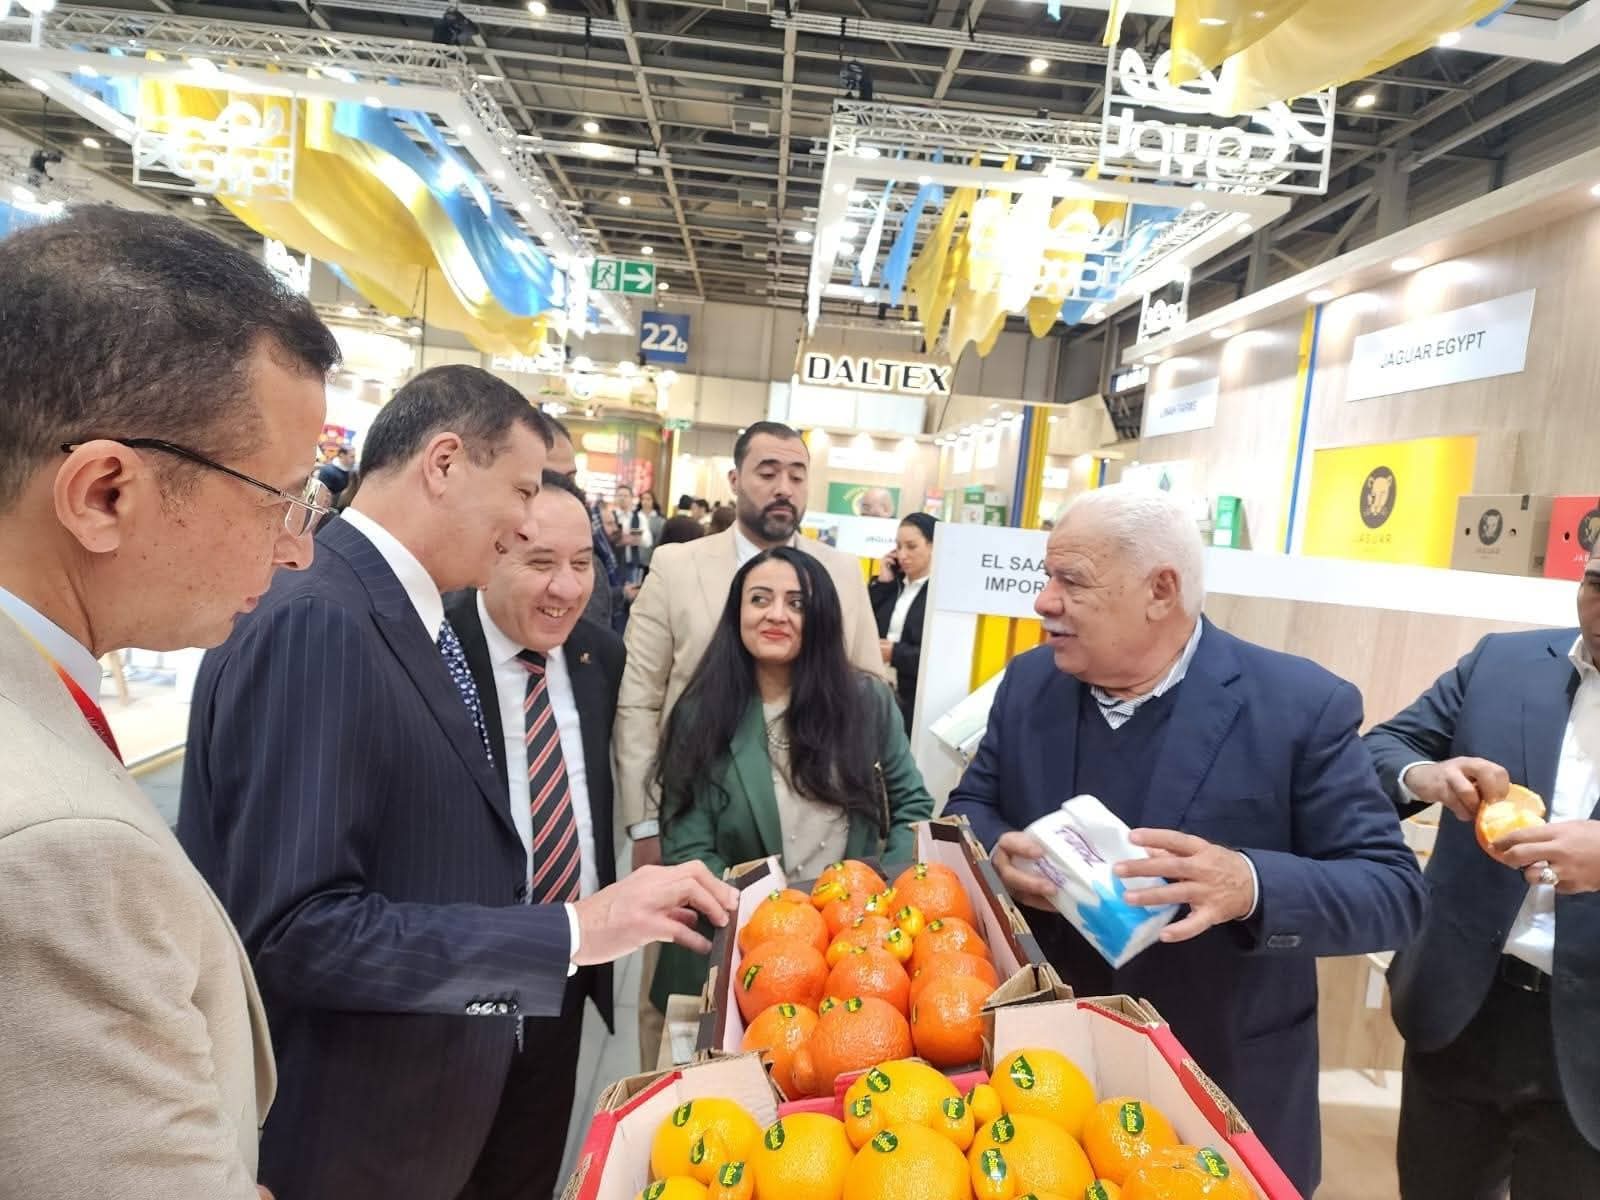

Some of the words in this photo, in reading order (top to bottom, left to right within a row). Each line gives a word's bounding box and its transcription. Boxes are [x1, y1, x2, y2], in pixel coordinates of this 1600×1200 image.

[641, 321, 689, 354] 22b
[1380, 343, 1432, 368] JAGUAR
[1434, 330, 1487, 358] EGYPT
[807, 356, 950, 392] DALTEX
[980, 553, 1005, 569] EL
[1009, 555, 1047, 572] SAA
[984, 575, 1046, 595] IMPOR
